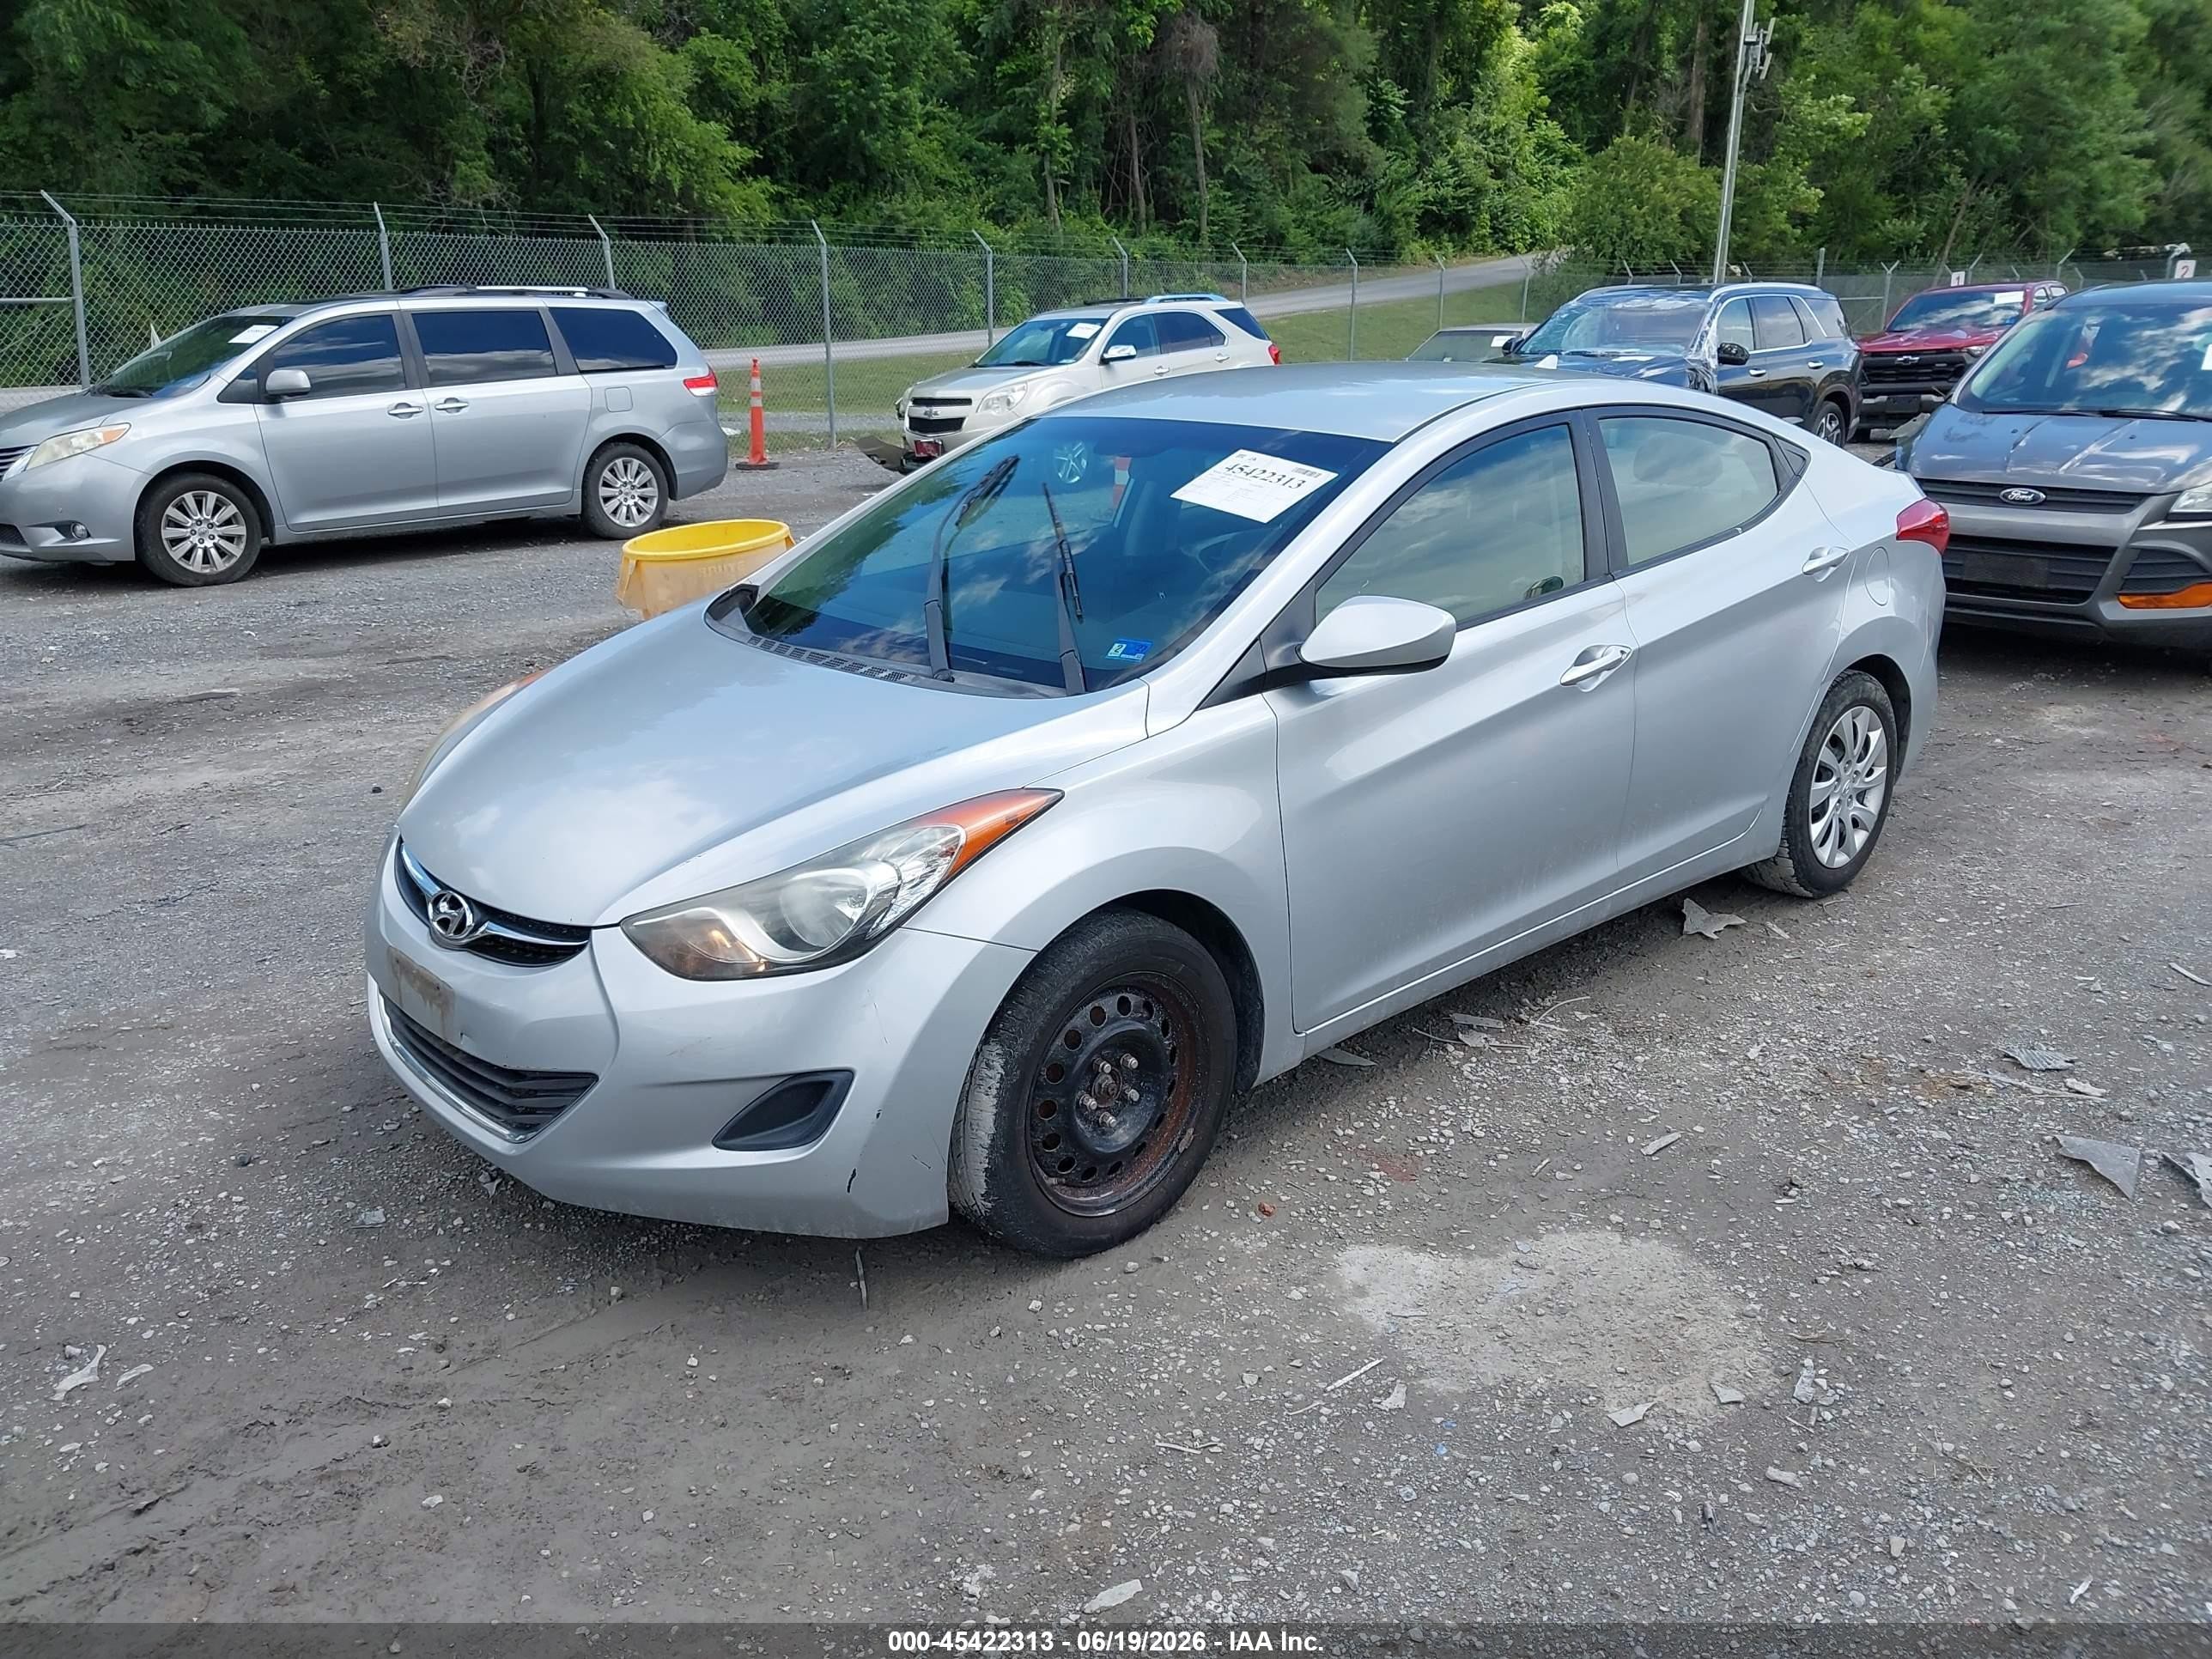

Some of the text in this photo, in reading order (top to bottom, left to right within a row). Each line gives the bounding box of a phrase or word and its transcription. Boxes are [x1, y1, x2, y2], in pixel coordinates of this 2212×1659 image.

[2181, 265, 2190, 278] 2
[1224, 463, 1306, 489] 45422313
[2008, 490, 2034, 501] Ford
